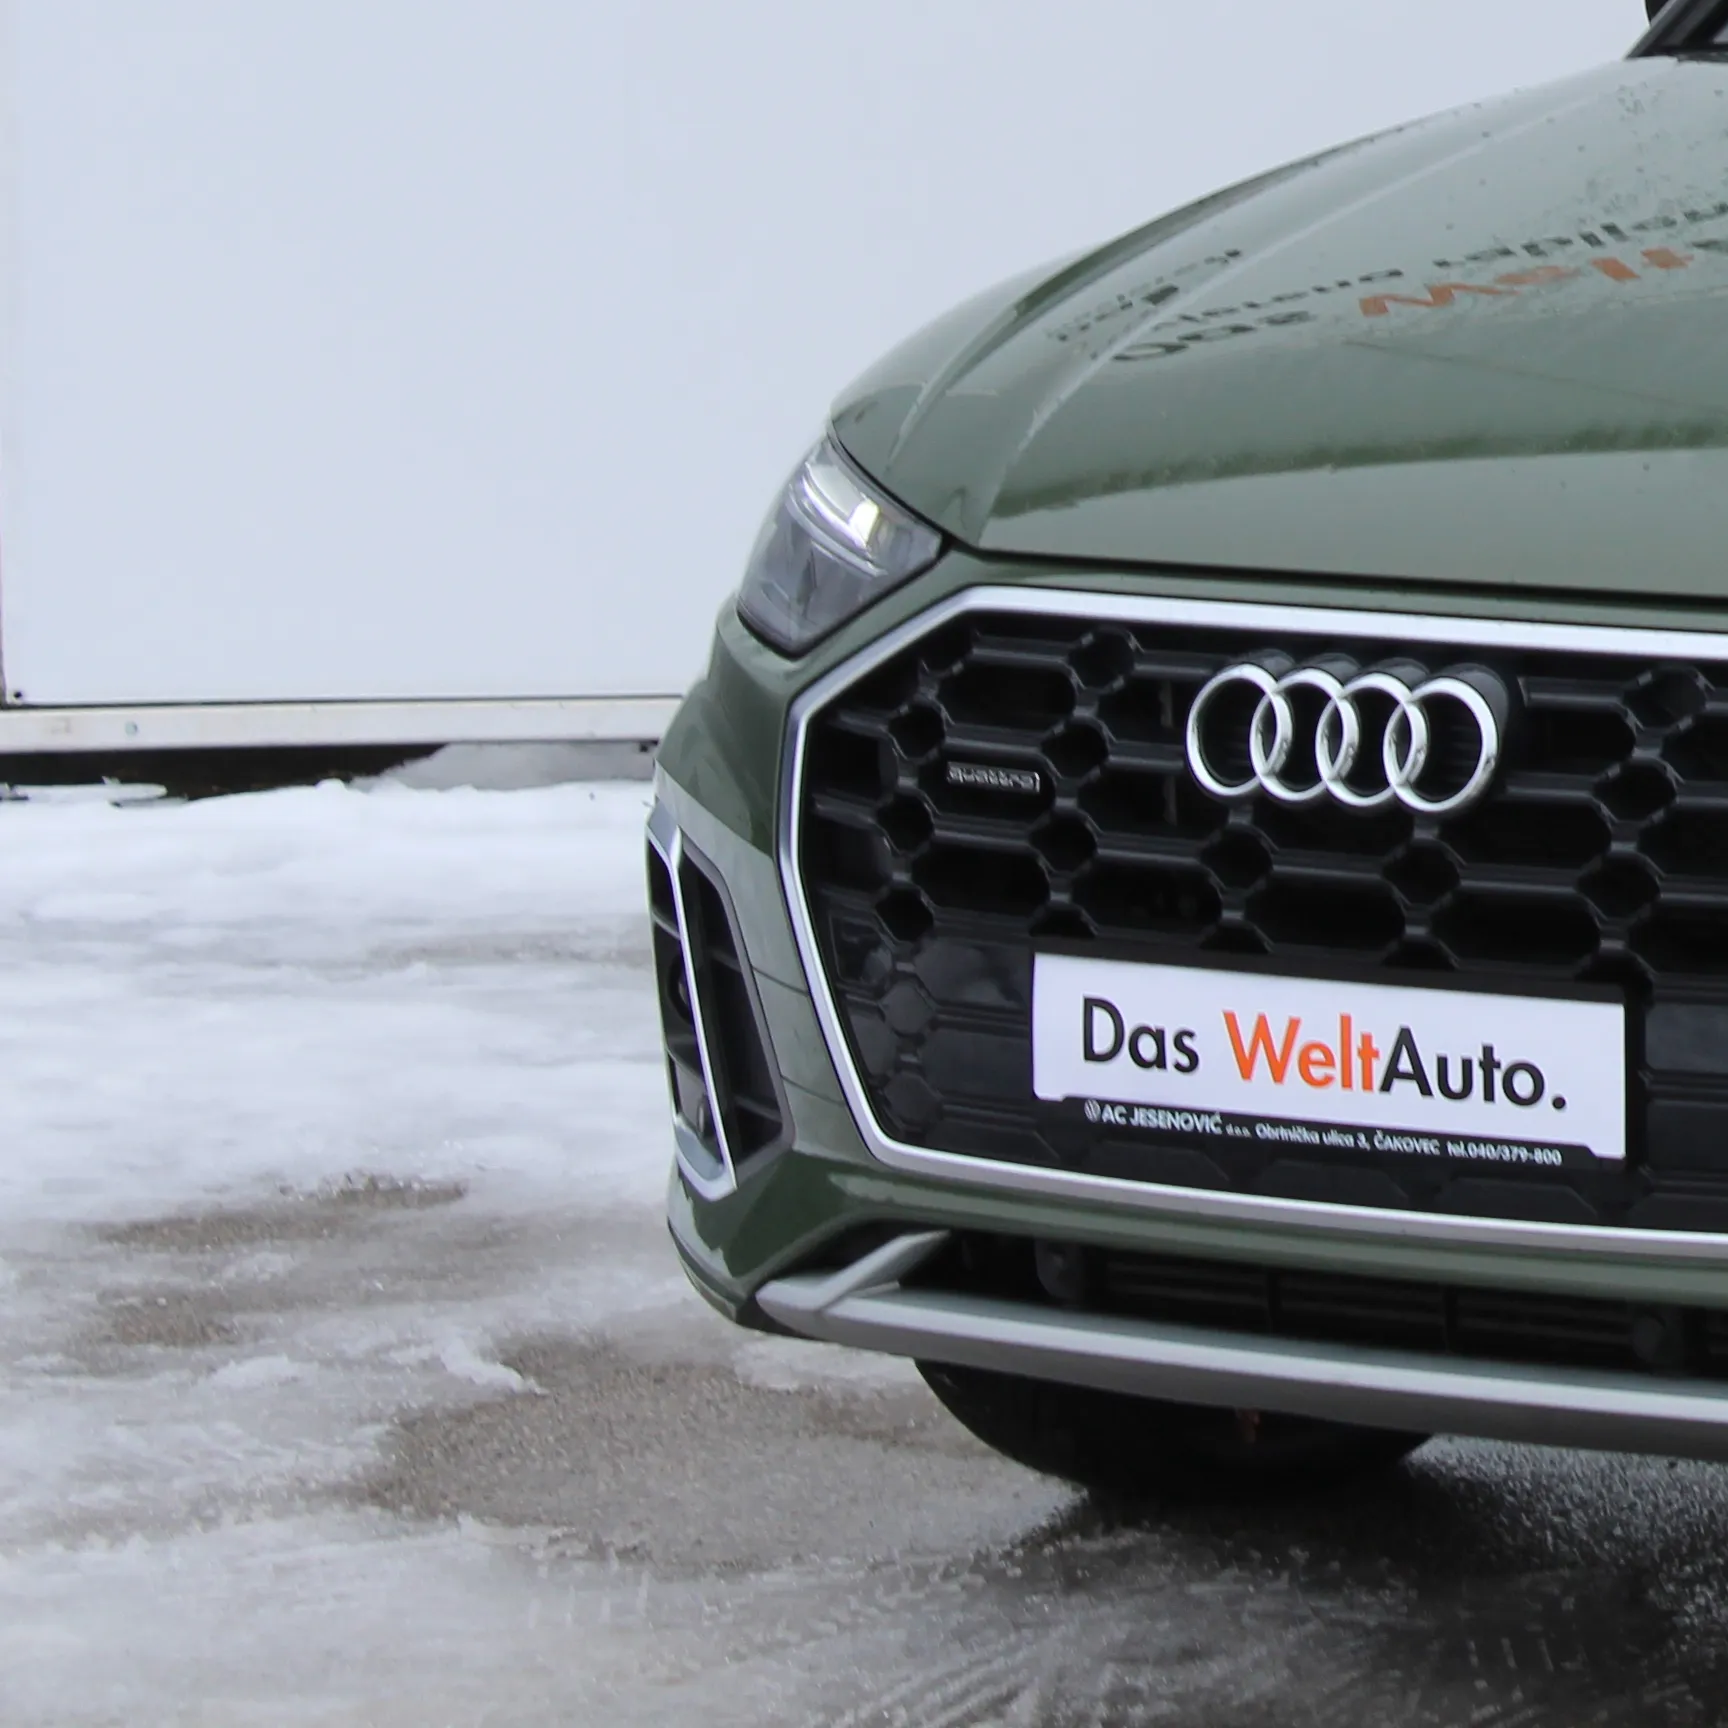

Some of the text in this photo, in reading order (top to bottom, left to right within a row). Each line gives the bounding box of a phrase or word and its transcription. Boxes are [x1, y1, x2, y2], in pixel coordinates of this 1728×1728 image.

[1082, 996, 1568, 1112] Das WeltAuto.
[1102, 1103, 1127, 1126] AC
[1129, 1108, 1223, 1135] JESENOVIĆ
[1373, 1129, 1441, 1156] ČAKOVEC
